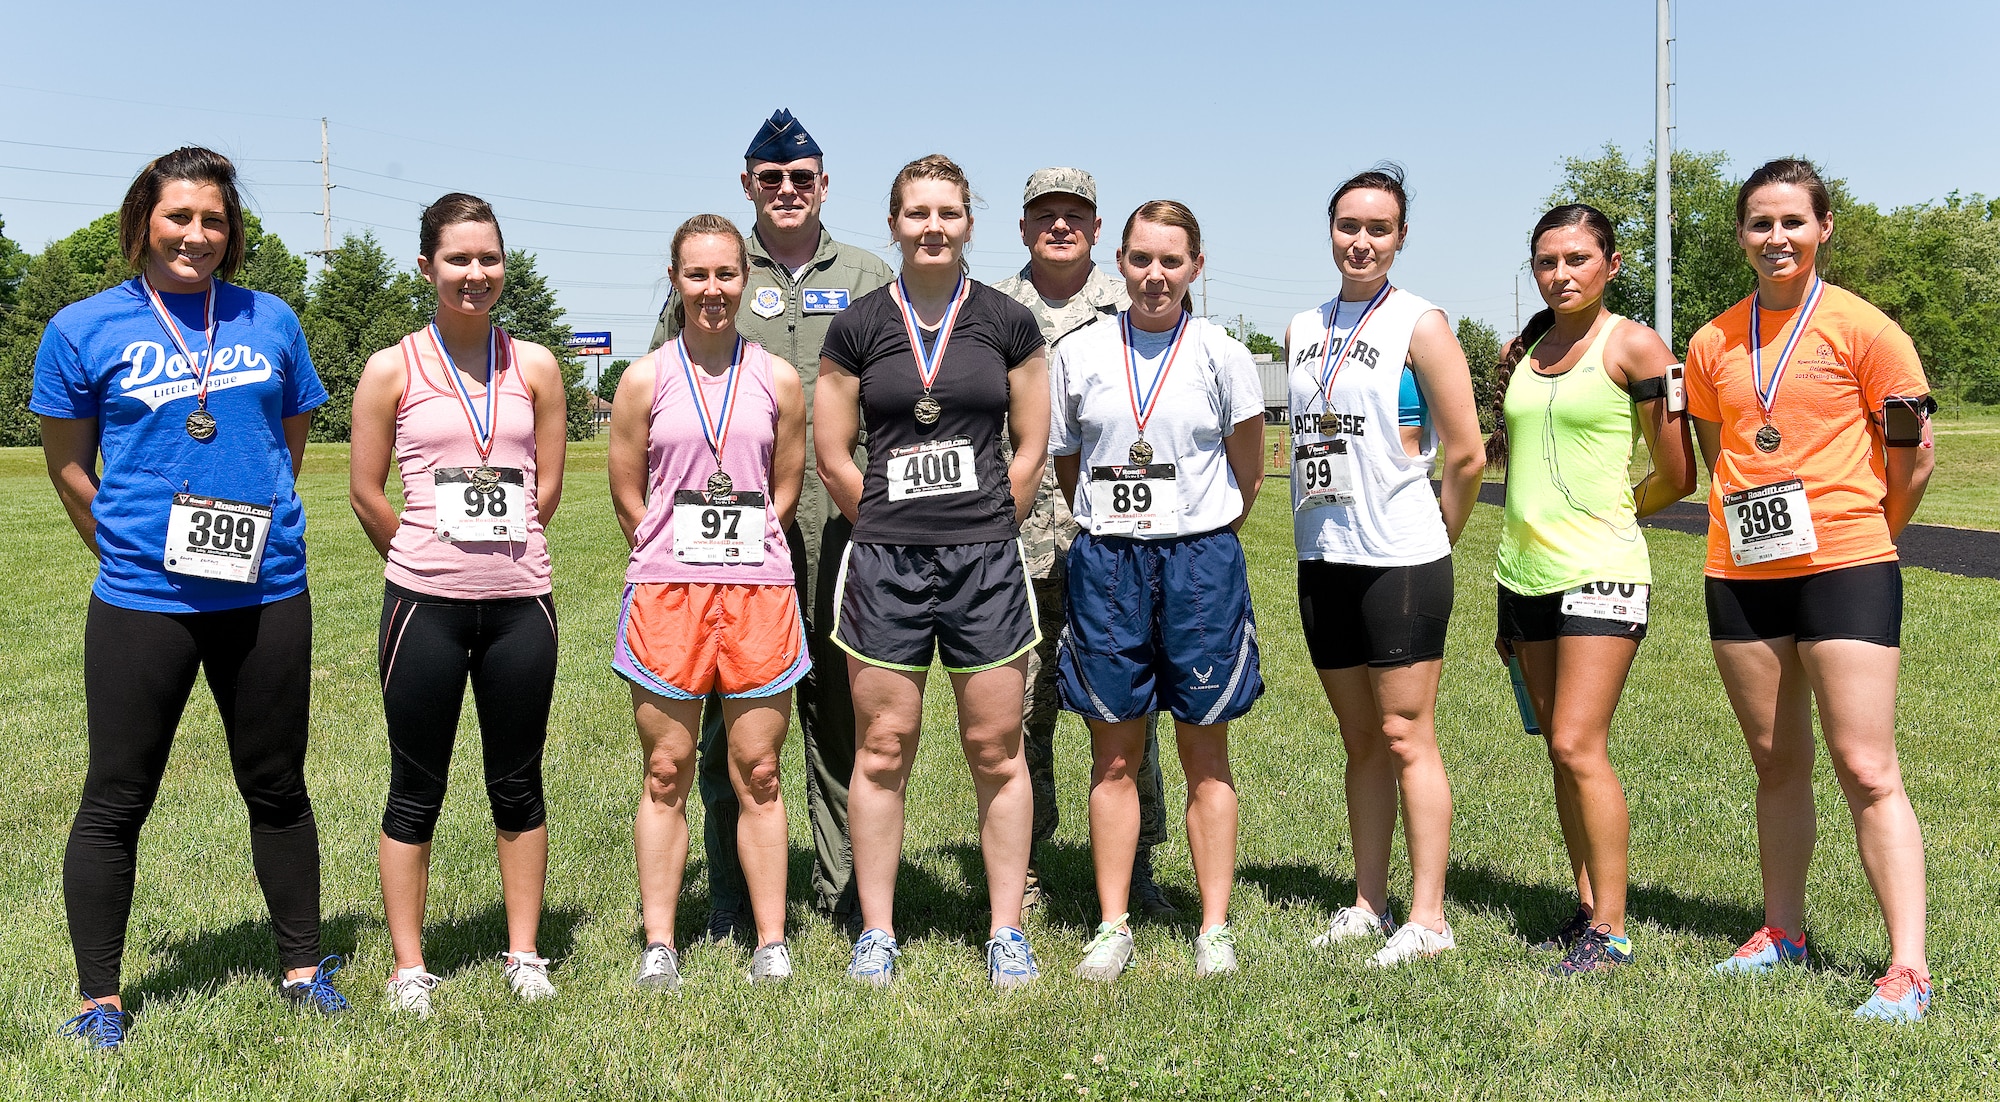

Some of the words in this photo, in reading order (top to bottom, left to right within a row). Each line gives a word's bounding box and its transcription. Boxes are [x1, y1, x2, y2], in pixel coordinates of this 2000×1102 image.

[120, 340, 263, 389] Dover
[1296, 337, 1380, 370] RADRS
[154, 384, 188, 399] Little
[192, 374, 238, 391] Lague
[1290, 414, 1366, 436] ACRSSE
[903, 450, 962, 486] 400
[1306, 458, 1332, 490] 99
[464, 485, 508, 517] 98
[1113, 482, 1152, 513] 89
[1747, 482, 1801, 500] RoadID.com
[214, 501, 272, 518] RoadID.com
[701, 508, 742, 539] 97
[1737, 496, 1792, 537] 398
[188, 510, 255, 553] 399
